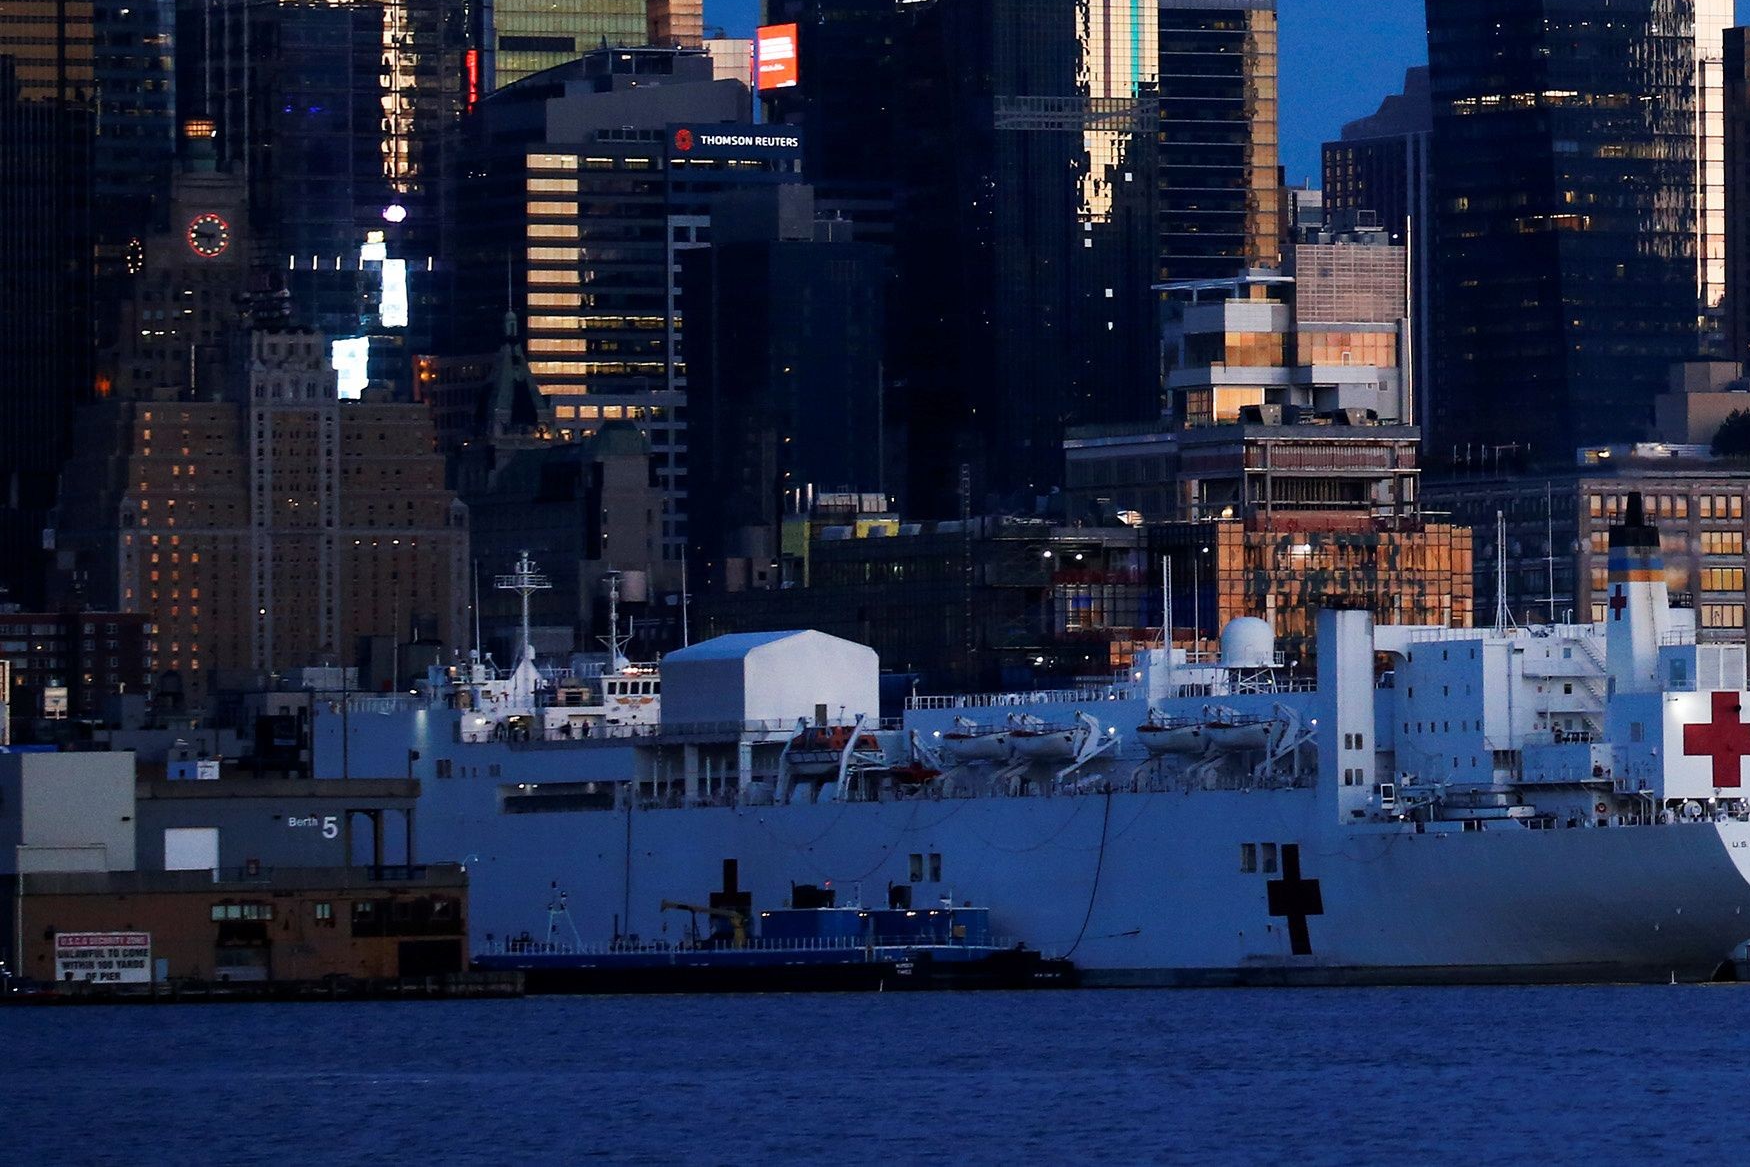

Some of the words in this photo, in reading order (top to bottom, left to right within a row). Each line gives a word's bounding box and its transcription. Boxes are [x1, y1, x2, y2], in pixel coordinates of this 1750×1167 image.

[700, 135, 753, 146] THOMSON
[755, 136, 799, 147] REUTERS
[288, 816, 319, 827] Berth
[322, 816, 339, 839] 5
[57, 949, 106, 958] UNLAWFUL
[107, 949, 120, 958] TO
[122, 949, 149, 957] COME
[62, 961, 95, 970] WITHIN
[116, 960, 145, 969] YARDS
[85, 972, 97, 980] OF
[100, 972, 121, 980] PIER
